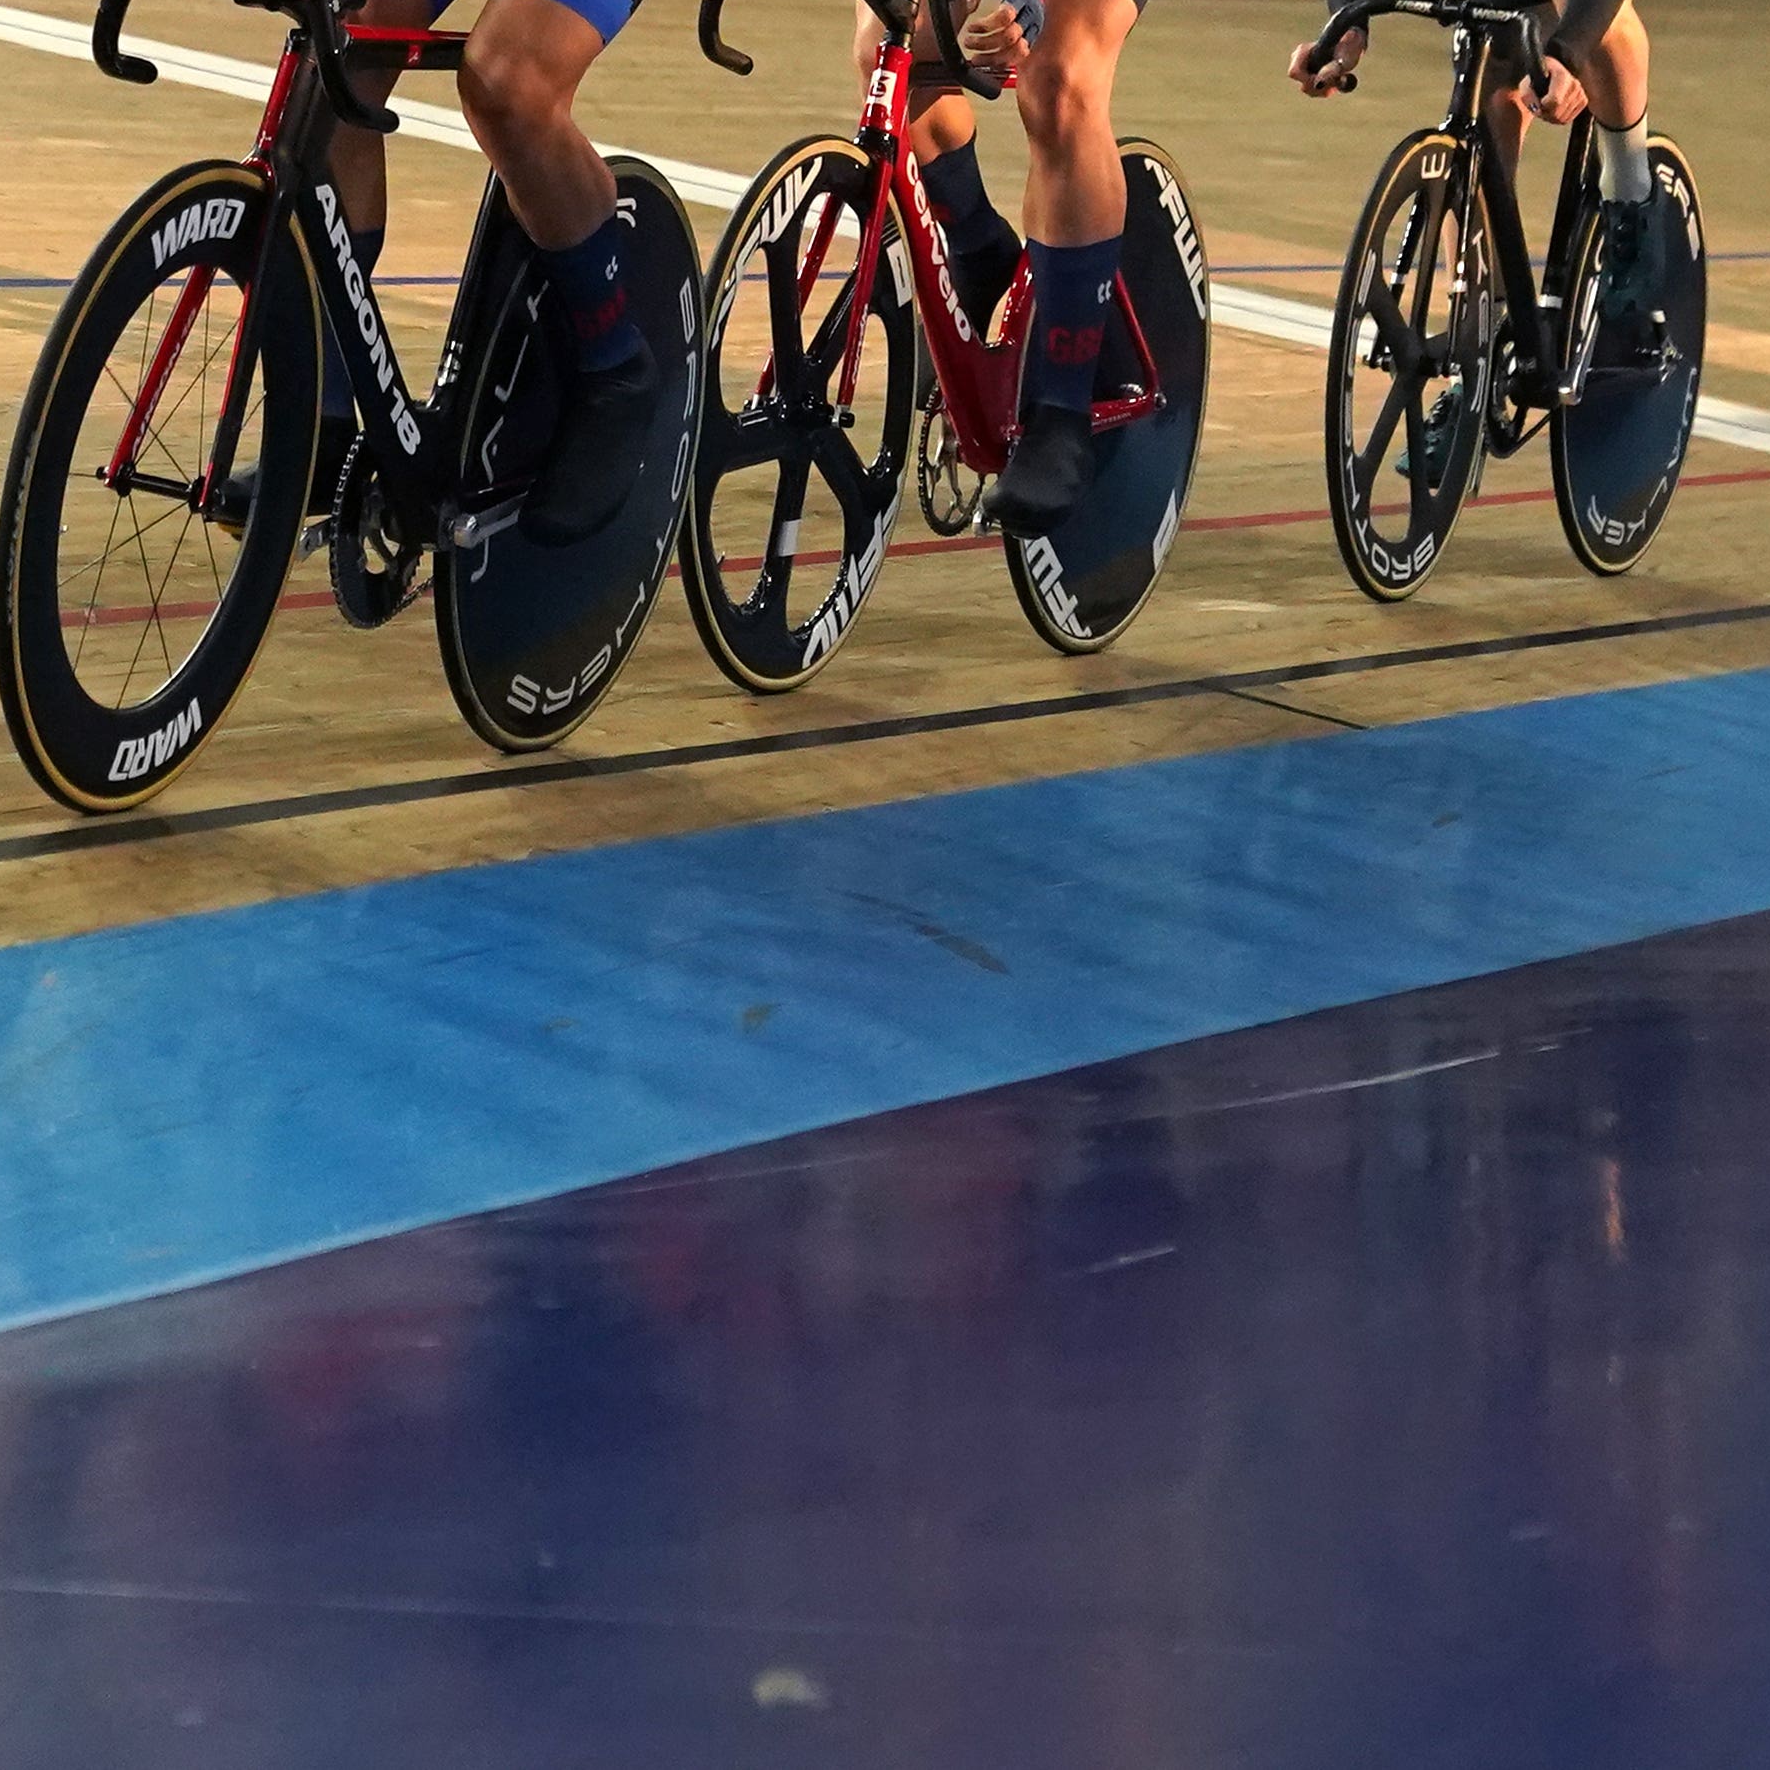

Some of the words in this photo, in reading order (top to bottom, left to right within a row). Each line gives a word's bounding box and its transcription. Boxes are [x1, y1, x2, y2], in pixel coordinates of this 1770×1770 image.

[151, 197, 245, 270] WARD
[315, 183, 394, 394] ARGON
[389, 385, 422, 456] 18
[506, 276, 696, 717] BROTHERS
[108, 696, 202, 782] WARD
